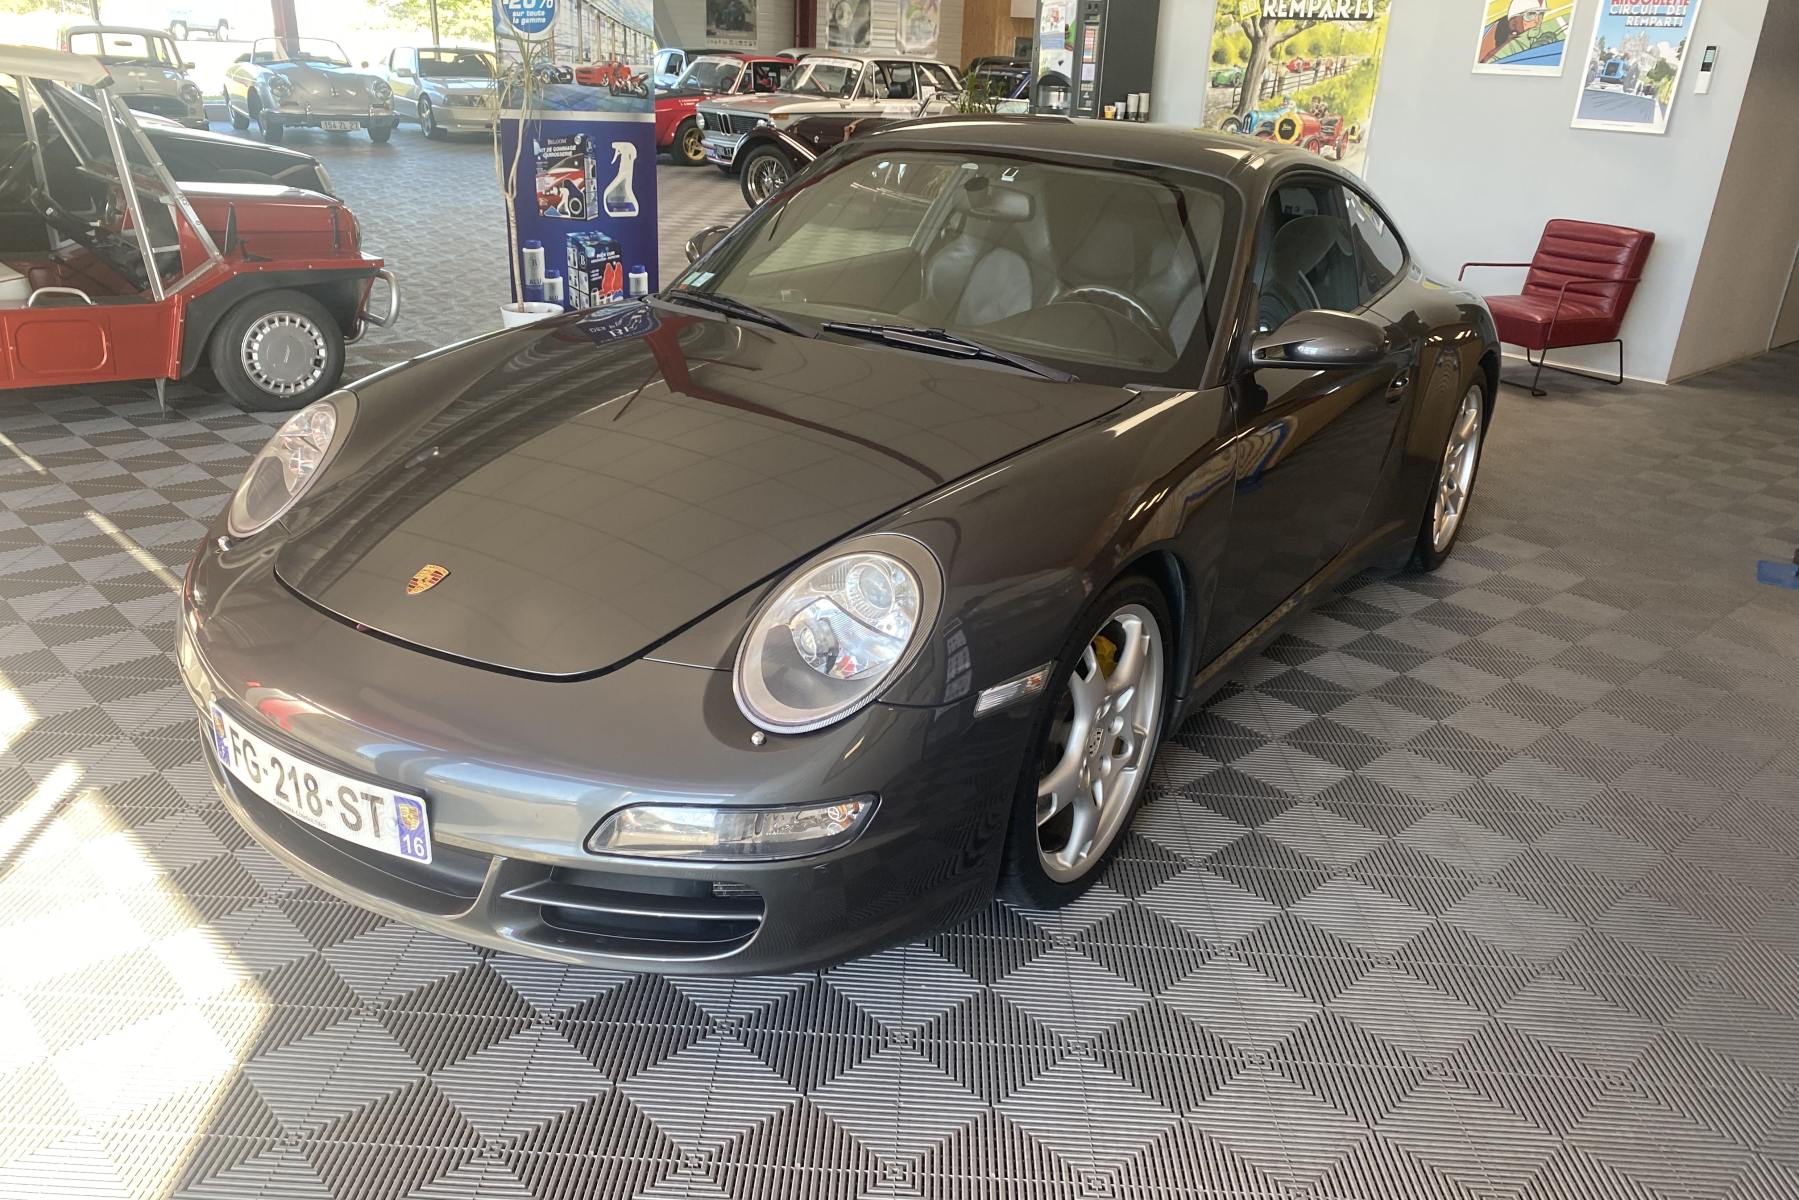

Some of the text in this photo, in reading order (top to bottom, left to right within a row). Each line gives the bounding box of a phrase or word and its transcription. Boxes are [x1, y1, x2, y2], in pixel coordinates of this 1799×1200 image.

[1263, 0, 1375, 20] REMPARTS
[1610, 4, 1659, 15] CIRCUIT
[521, 18, 546, 26] gamme
[1626, 16, 1684, 27] REMPARTS
[229, 726, 385, 839] FG-218-ST
[402, 833, 425, 857] 16
